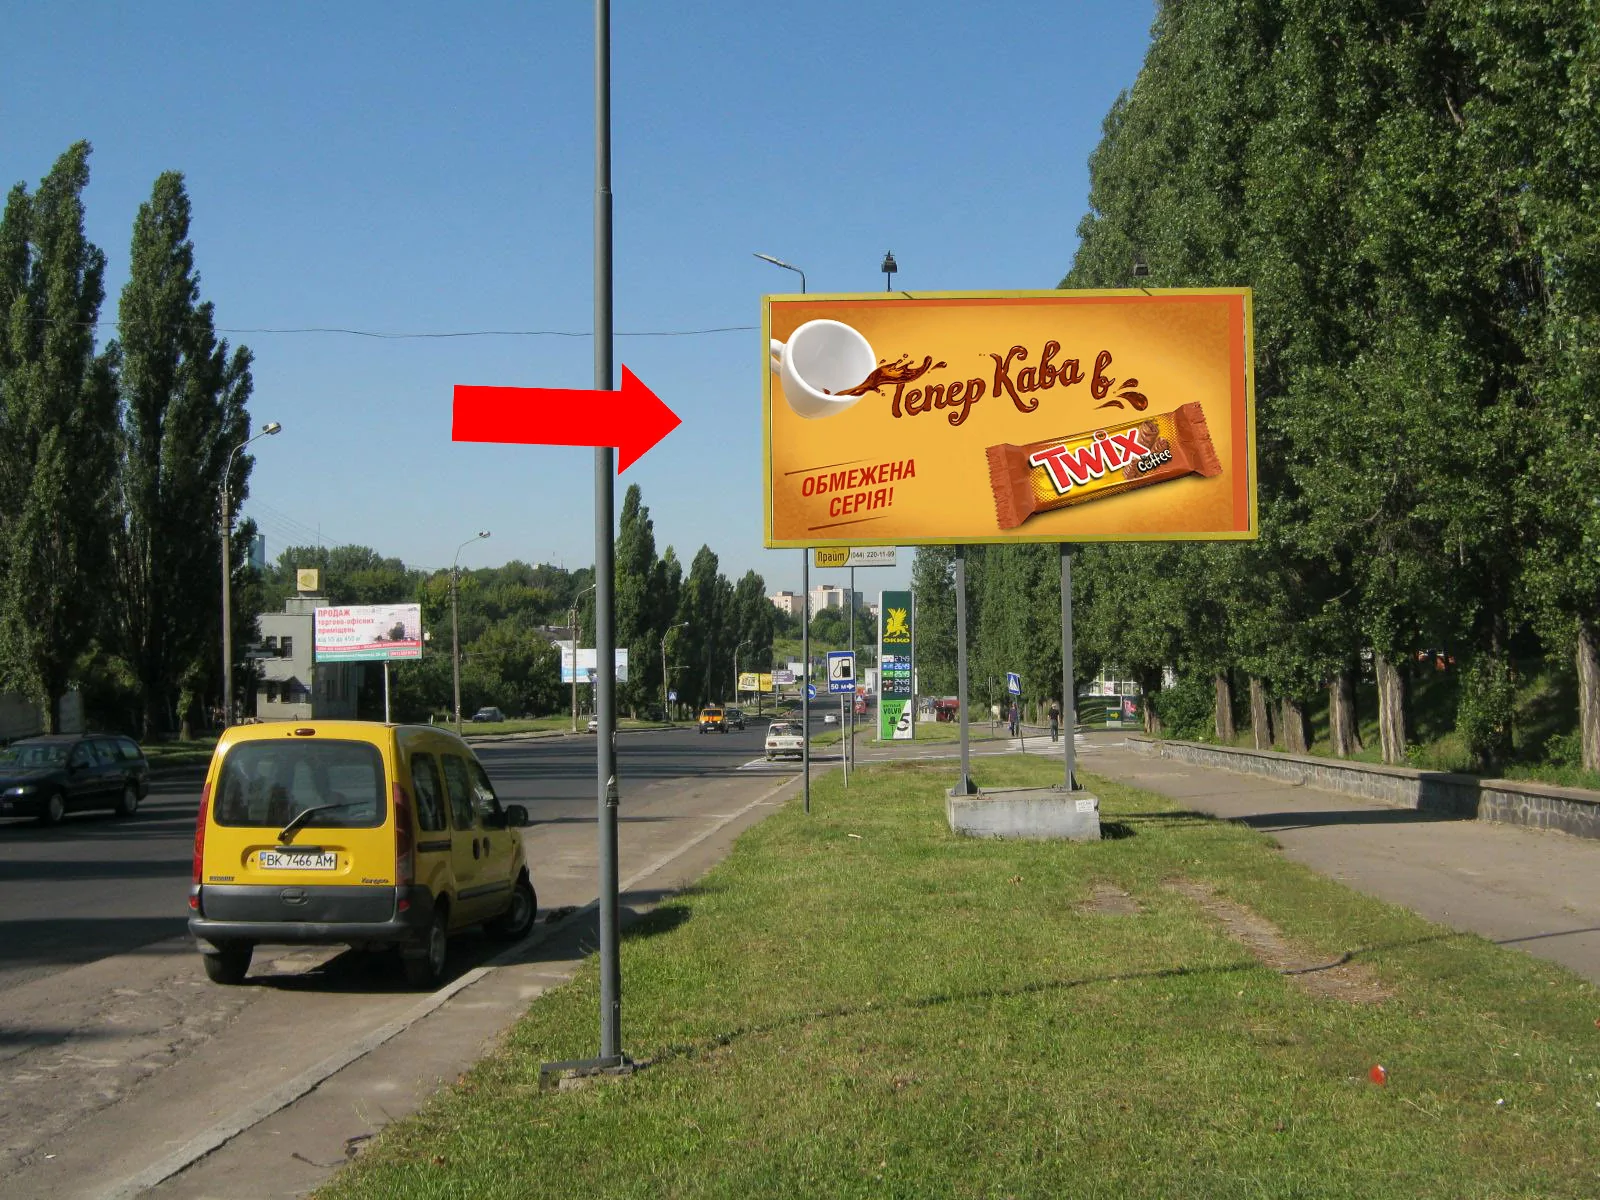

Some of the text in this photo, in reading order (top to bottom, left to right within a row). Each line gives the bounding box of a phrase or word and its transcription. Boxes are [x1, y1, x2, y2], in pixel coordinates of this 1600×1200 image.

[989, 340, 1085, 413] Кава
[801, 458, 916, 497] ОБМЕЖЕНА
[1030, 430, 1150, 494] Twix
[829, 486, 894, 518] СЕРІЯ!
[318, 609, 351, 618] ПРОДАЖ
[896, 713, 910, 731] 5
[286, 854, 312, 866] 7466
